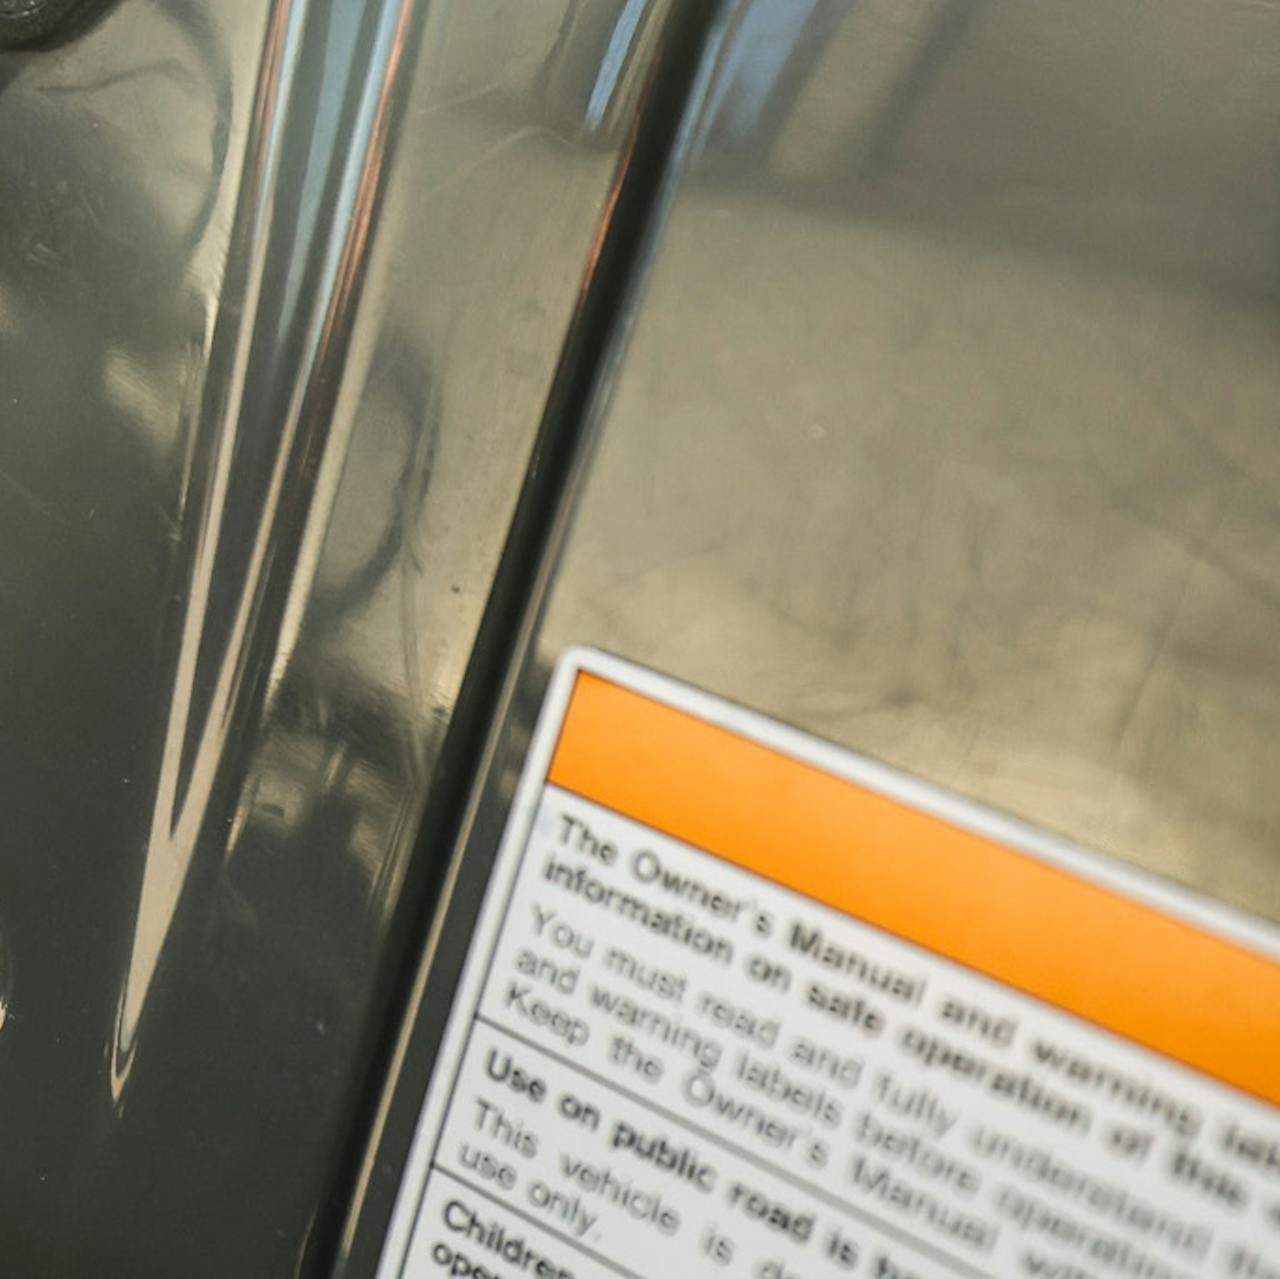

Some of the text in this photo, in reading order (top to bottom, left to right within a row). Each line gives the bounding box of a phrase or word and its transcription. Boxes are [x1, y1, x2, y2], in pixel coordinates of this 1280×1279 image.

[542, 850, 735, 966] information
[743, 954, 794, 995] on
[557, 810, 619, 866] The
[630, 847, 773, 937] Owner's
[788, 920, 928, 1010] Manual
[506, 979, 1002, 1261] Keep the Owner's Manual
[513, 946, 581, 997] and
[589, 981, 724, 1075] warning
[735, 1048, 844, 1131] labels
[851, 1108, 983, 1202] before
[529, 900, 595, 961] You
[603, 943, 688, 1005] must
[696, 991, 781, 1050] read
[873, 1070, 959, 1141] fully
[457, 1142, 518, 1192] use
[473, 1094, 736, 1269] This vehicle is
[483, 1045, 548, 1104] Use
[555, 1091, 602, 1133] on
[610, 1119, 717, 1195] public
[726, 1181, 819, 1247] road
